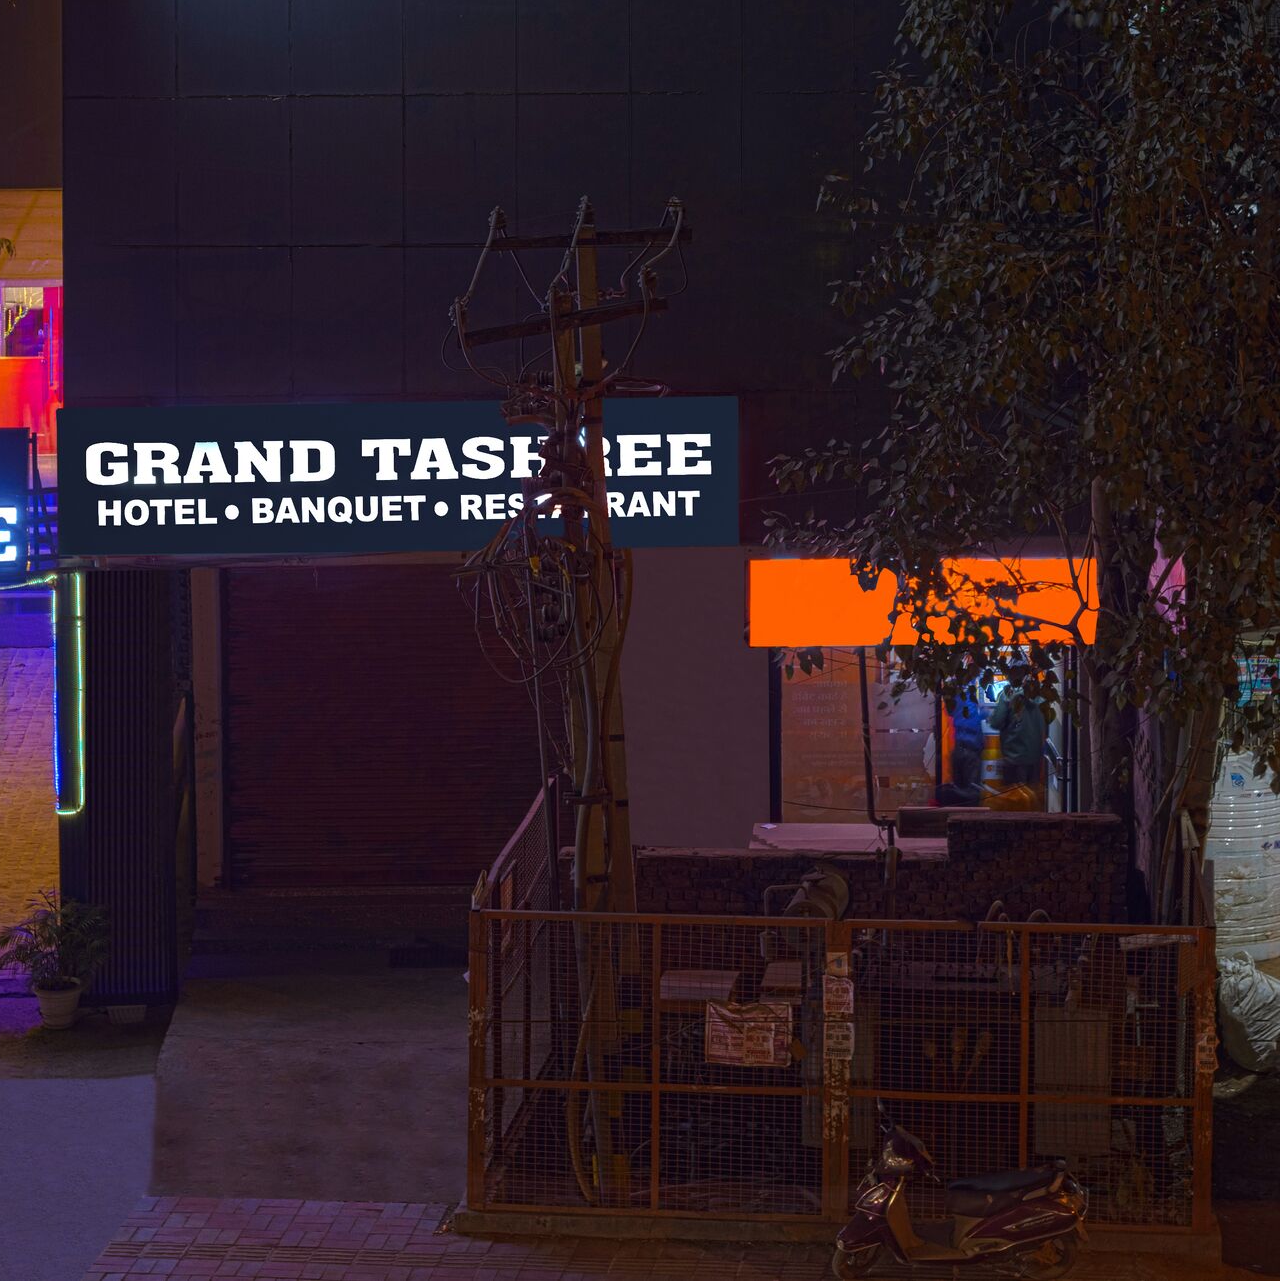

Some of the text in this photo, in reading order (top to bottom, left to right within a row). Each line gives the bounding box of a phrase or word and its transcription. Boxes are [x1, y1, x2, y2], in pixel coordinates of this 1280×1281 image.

[85, 433, 712, 486] GRAND TASHEE
[97, 490, 701, 527] HOTEL BANQUET RESRANT
